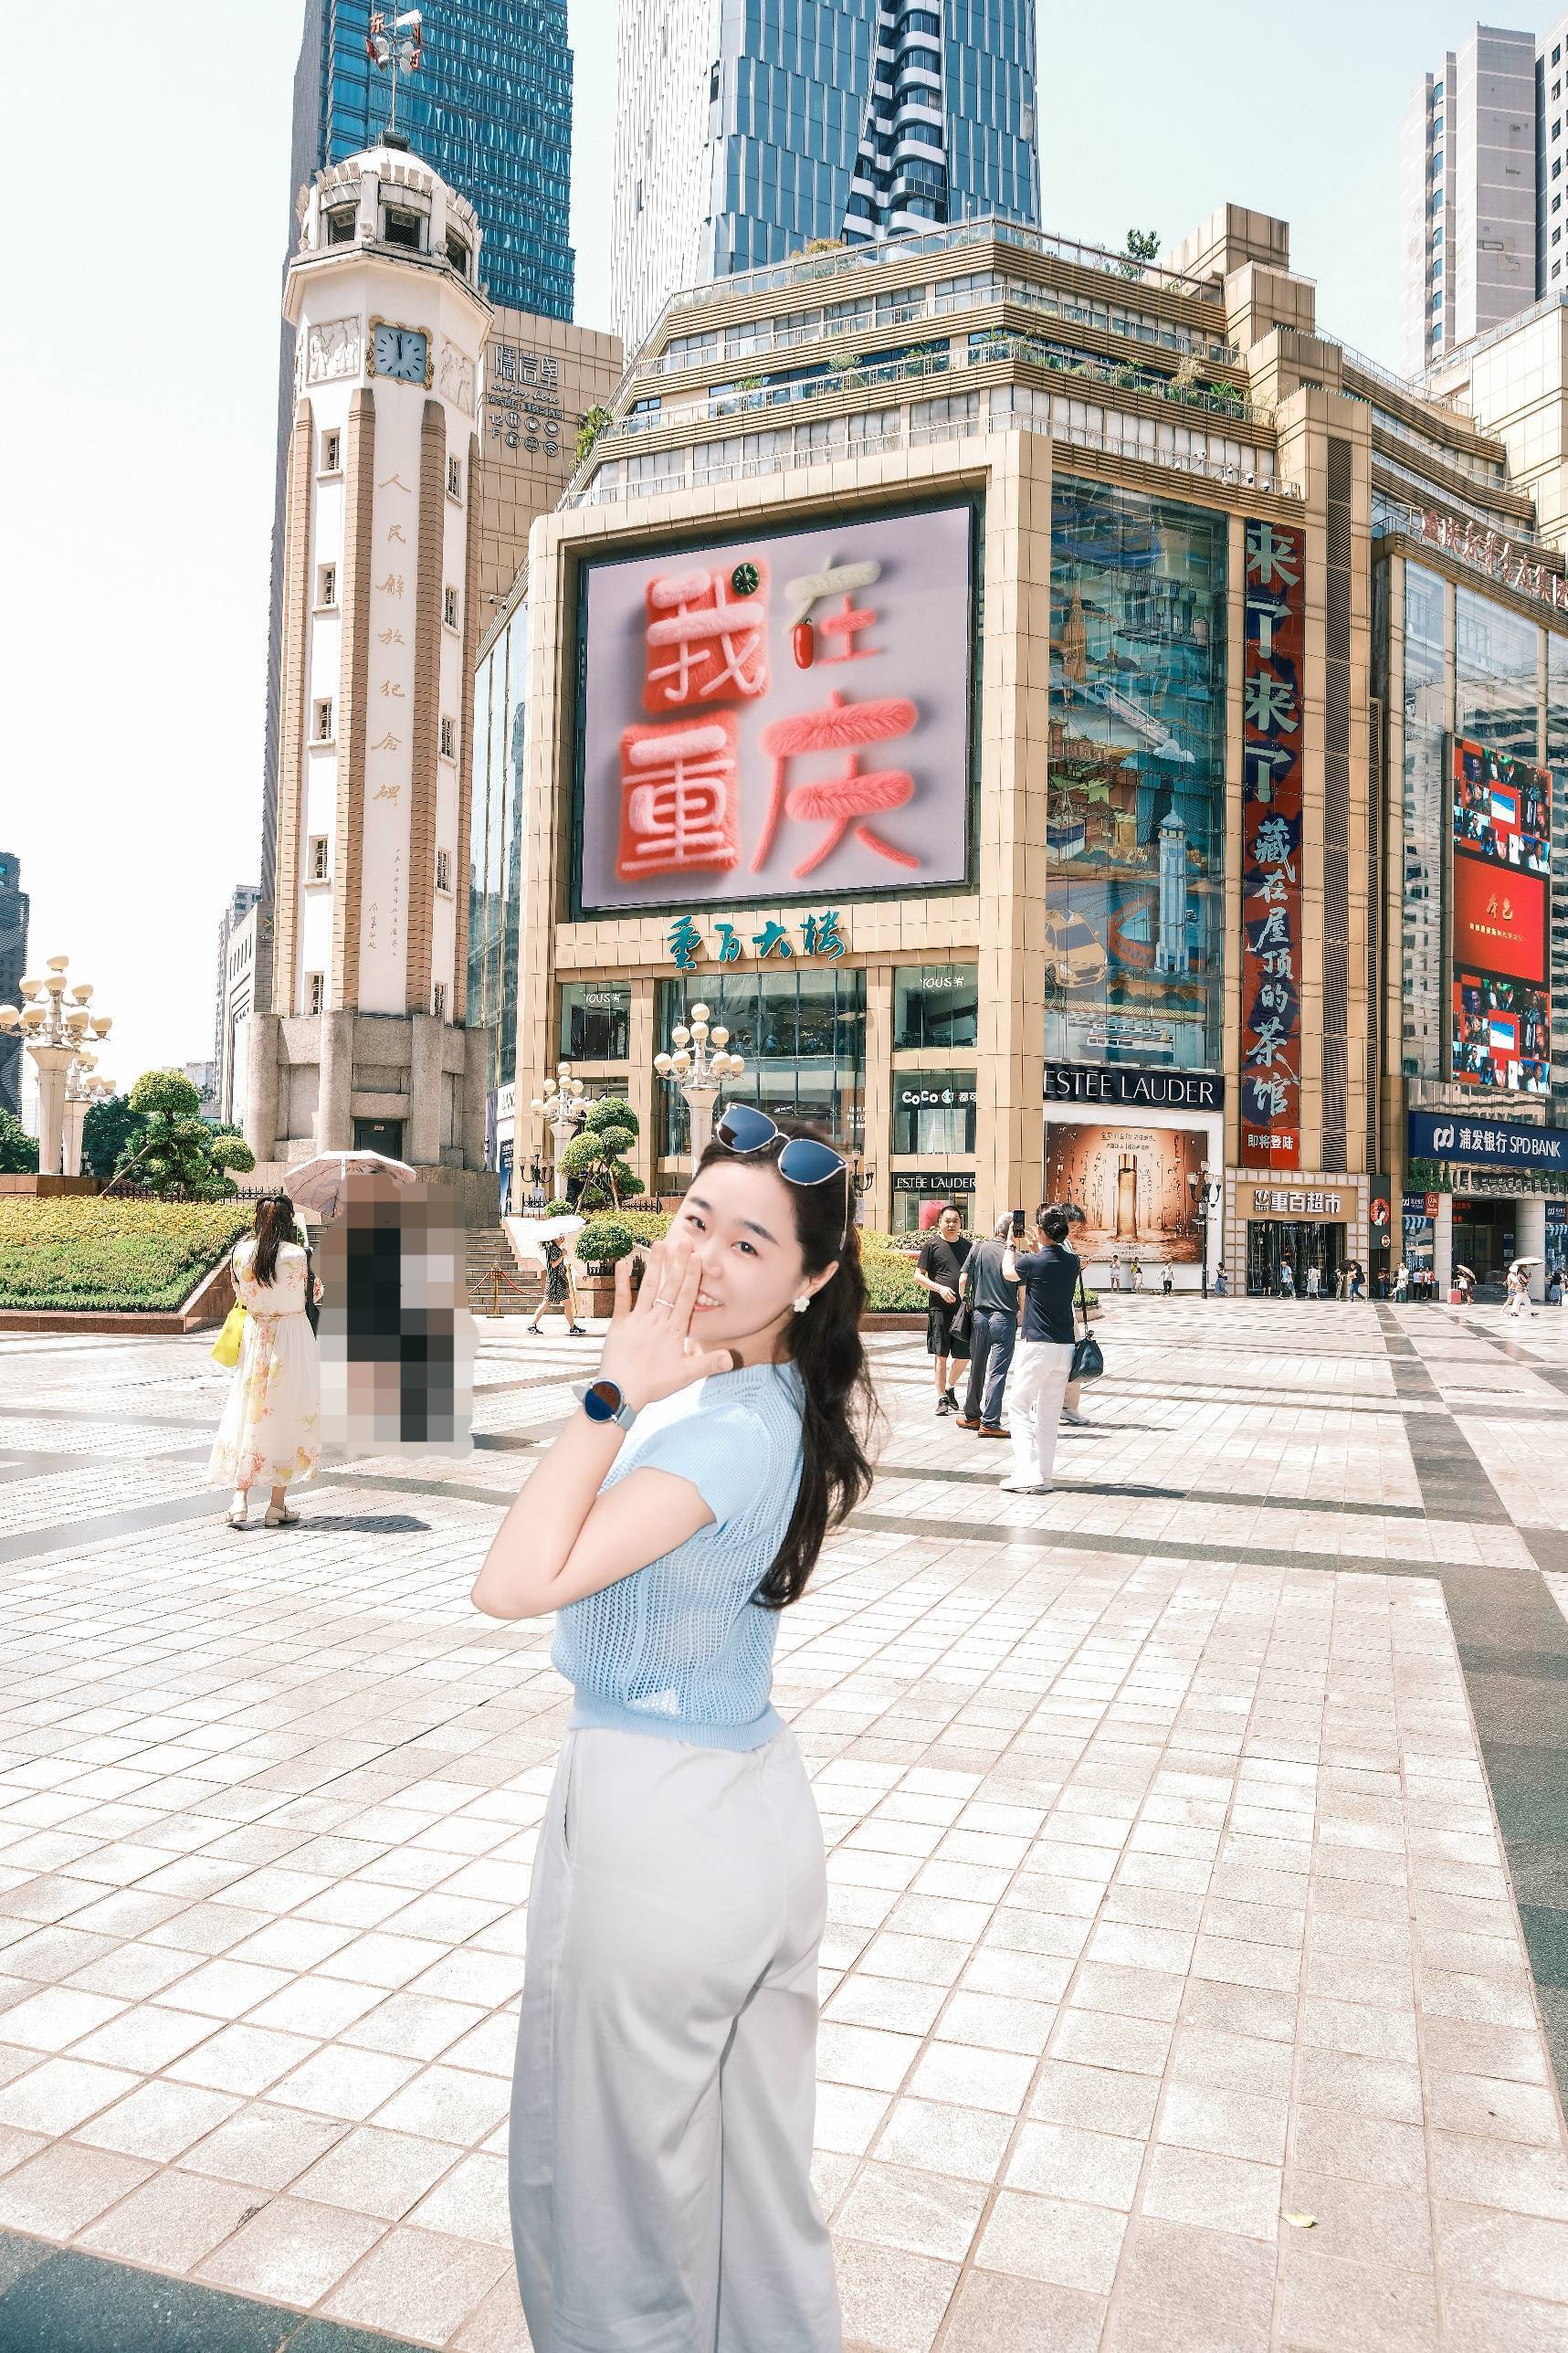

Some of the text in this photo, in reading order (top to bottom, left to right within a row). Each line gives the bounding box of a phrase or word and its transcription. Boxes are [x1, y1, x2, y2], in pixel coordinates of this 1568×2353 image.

[491, 383, 560, 404] enjoy here
[489, 413, 503, 427] 12
[647, 553, 884, 703] 我在
[1245, 522, 1301, 804] 来了来了
[619, 688, 921, 881] 重庆
[667, 910, 846, 970] 重百大楼
[1246, 818, 1300, 1117] 藏在屋顶的茶馆
[920, 977, 952, 988] YOUS
[583, 993, 611, 1004] YOUS
[1121, 1075, 1214, 1104] LAUDER
[1247, 1134, 1294, 1150] 即将登陆
[1458, 1128, 1562, 1158] 浦发银行 SPD BANK
[931, 1176, 976, 1188] LAUDER
[1270, 1190, 1342, 1214] 重百超市
